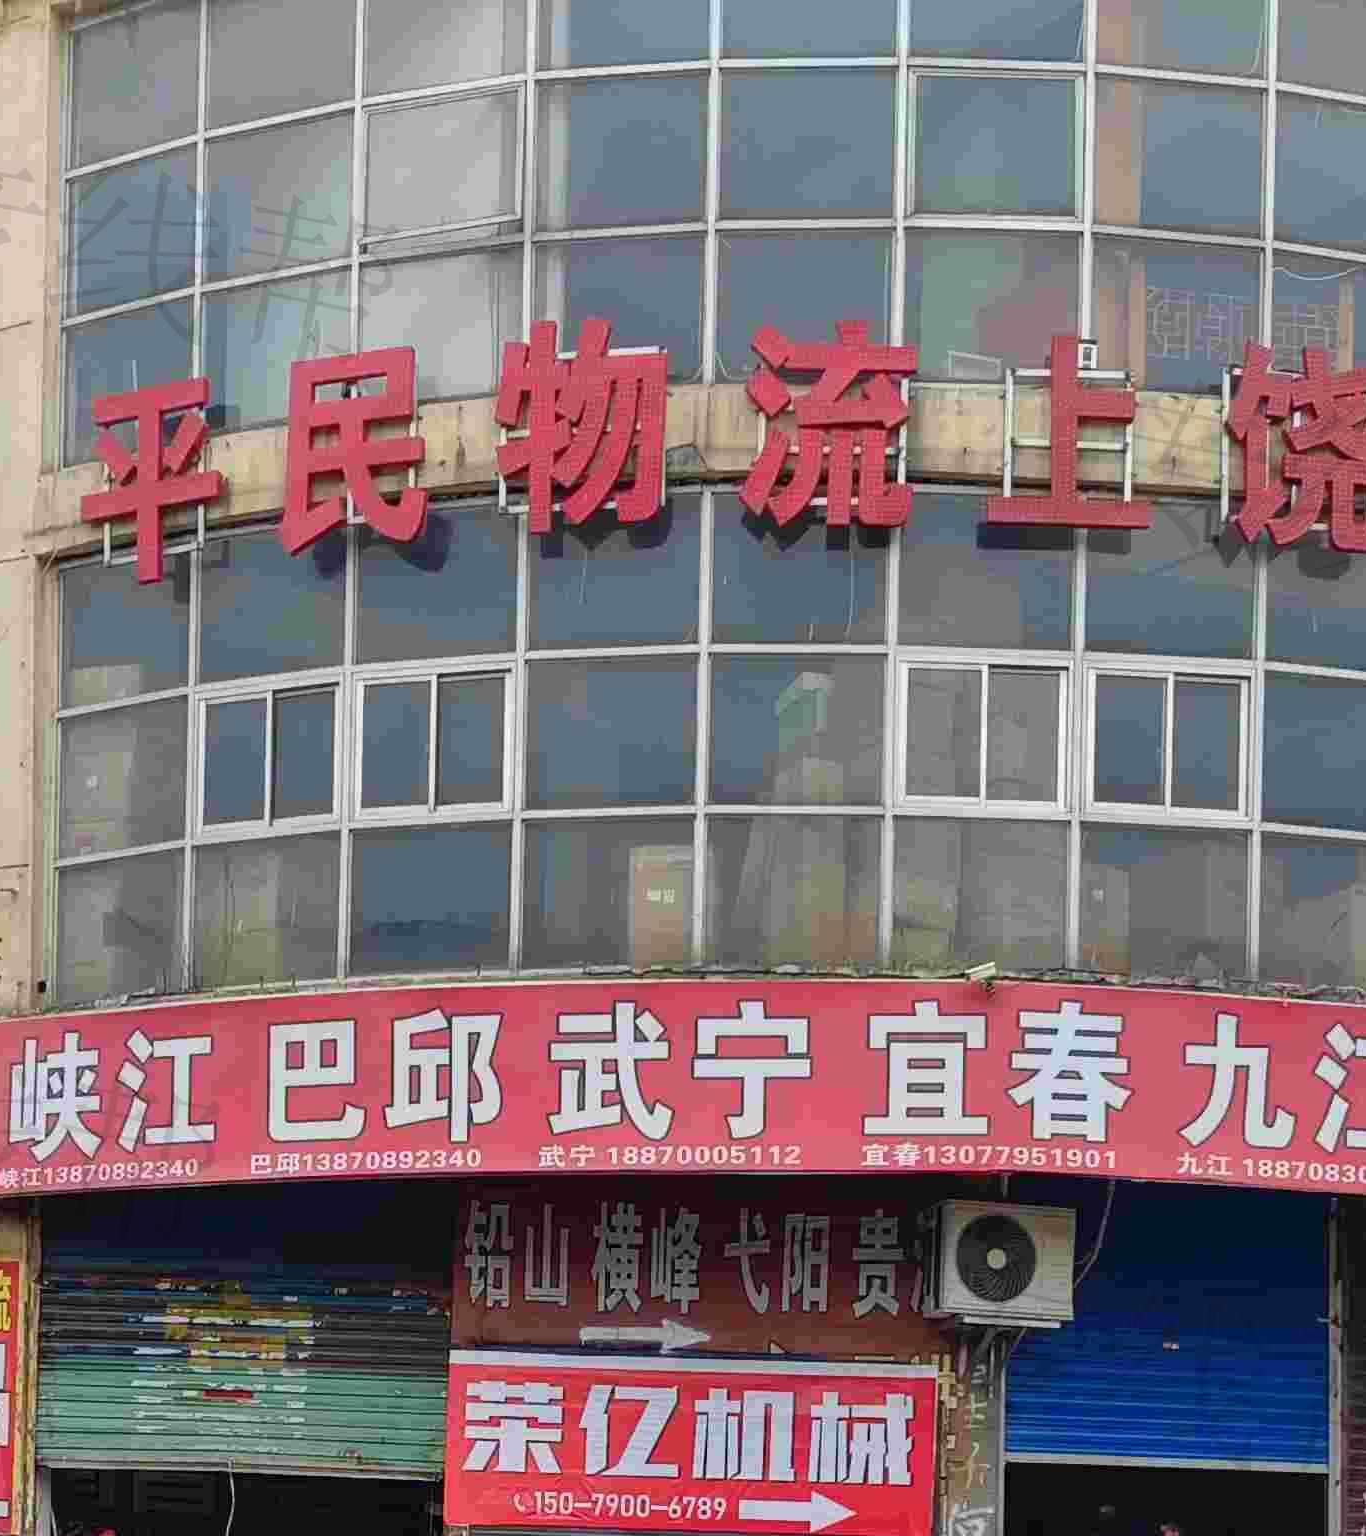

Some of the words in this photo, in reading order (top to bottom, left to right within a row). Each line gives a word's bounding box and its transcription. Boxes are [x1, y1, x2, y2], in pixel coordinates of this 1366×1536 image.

[8, 1028, 217, 1161] 峡江
[268, 1007, 504, 1144] 巴邱
[547, 1000, 812, 1141] 武宁
[862, 1000, 1132, 1143] 宜春
[249, 1147, 483, 1175] 巴邱13870892340
[607, 1145, 803, 1168] 18870005112
[860, 1142, 1117, 1170] 宜春13077951901
[465, 1203, 571, 1309] 铅山
[592, 1200, 702, 1313] 横峰
[461, 1379, 915, 1487] 荣亿机械
[534, 1491, 727, 1521] 150-7900-6789
